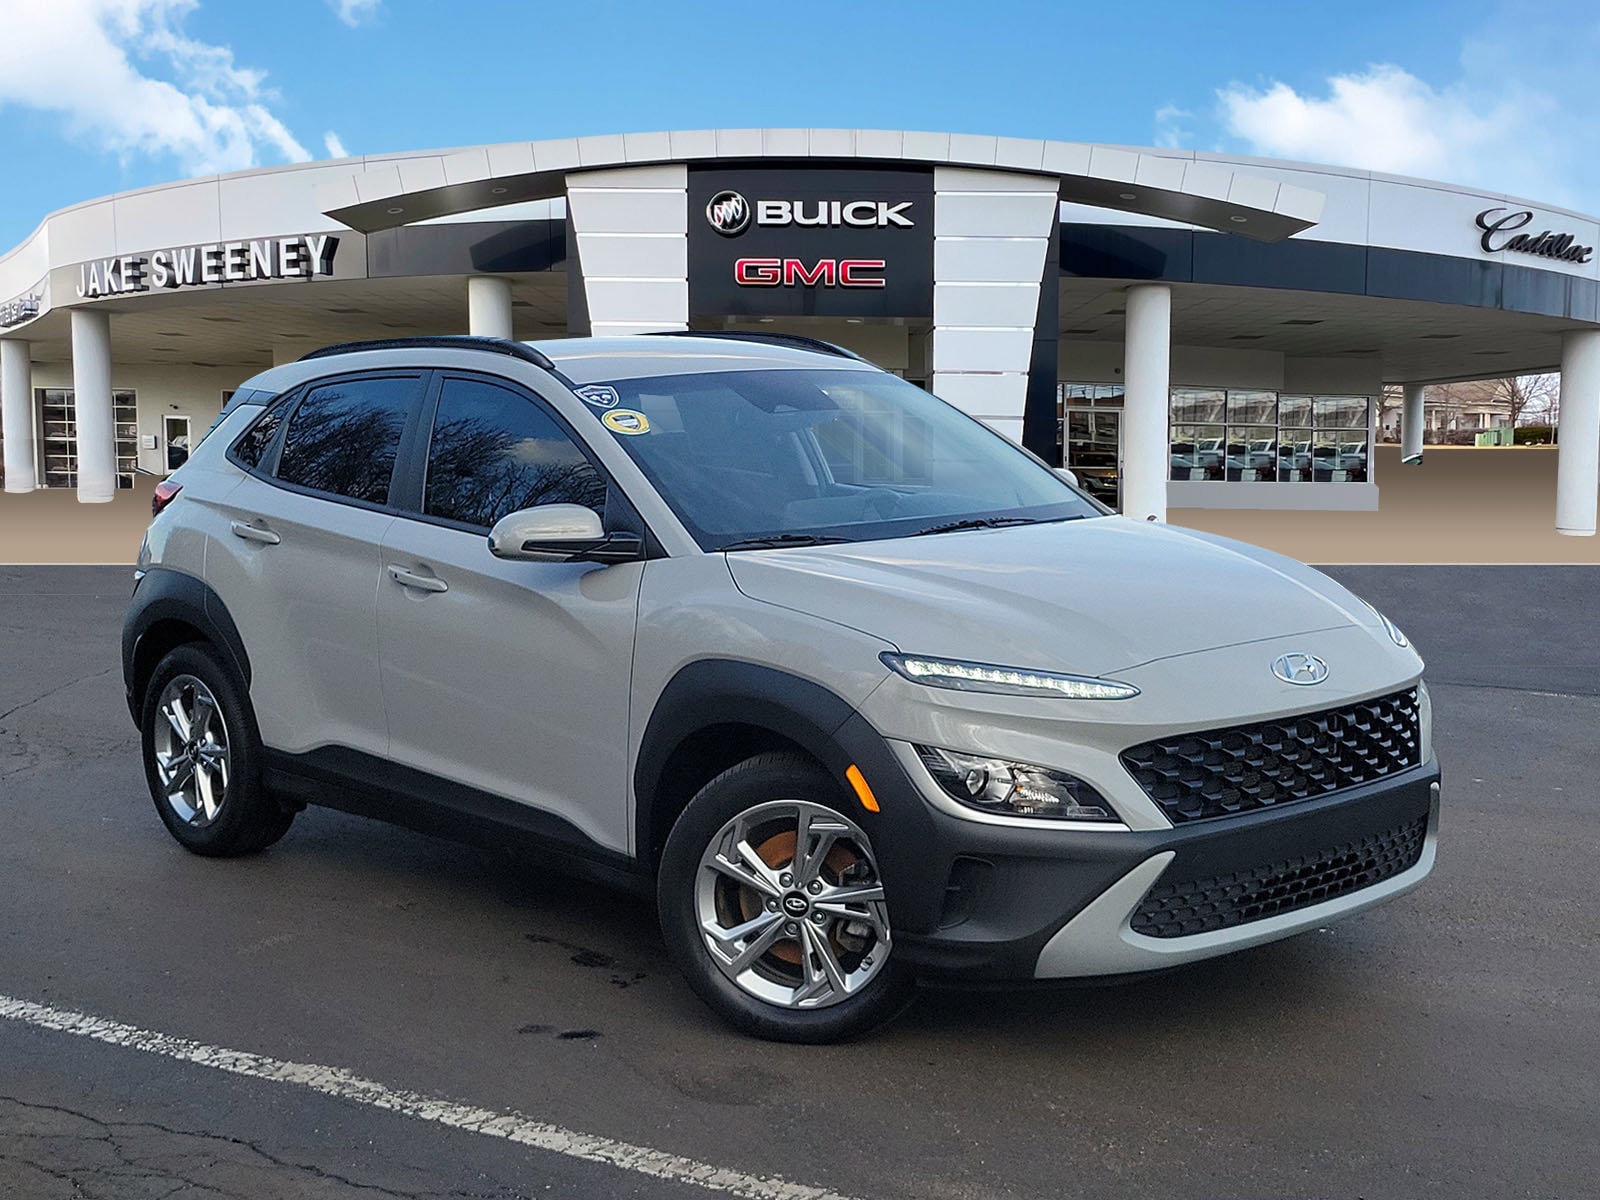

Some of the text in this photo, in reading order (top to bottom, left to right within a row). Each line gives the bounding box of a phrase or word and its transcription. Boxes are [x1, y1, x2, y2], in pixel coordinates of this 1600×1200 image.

[756, 200, 914, 226] BUICK
[1475, 207, 1593, 264] Cadillac
[76, 234, 333, 298] JAKE SWEENEY
[735, 258, 886, 287] GMC
